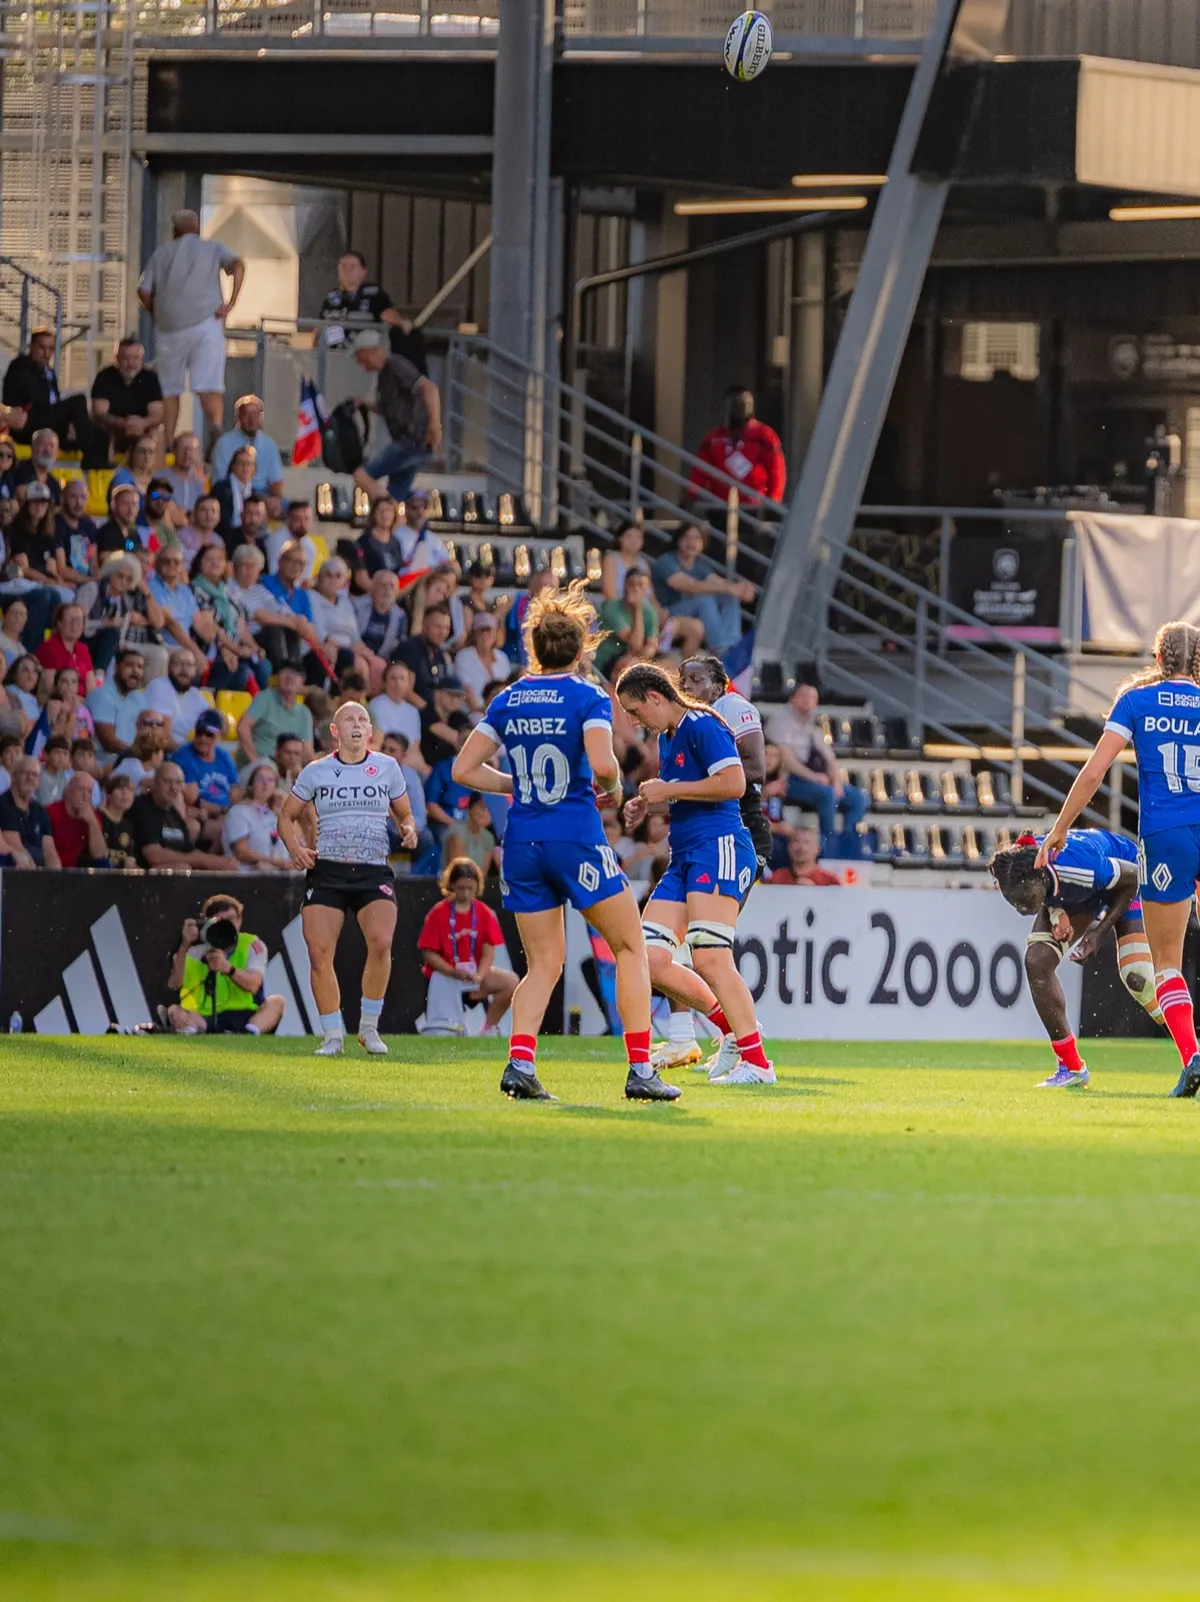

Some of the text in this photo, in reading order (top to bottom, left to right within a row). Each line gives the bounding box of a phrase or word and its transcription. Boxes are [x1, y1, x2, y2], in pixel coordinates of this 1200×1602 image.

[747, 24, 766, 75] GILBERT
[521, 696, 564, 704] GENERALE
[504, 717, 567, 736] ARBEZ
[509, 743, 571, 806] 10
[320, 785, 389, 800] PICTON
[328, 800, 381, 808] INVESTMENTS
[733, 909, 850, 1005] ptic
